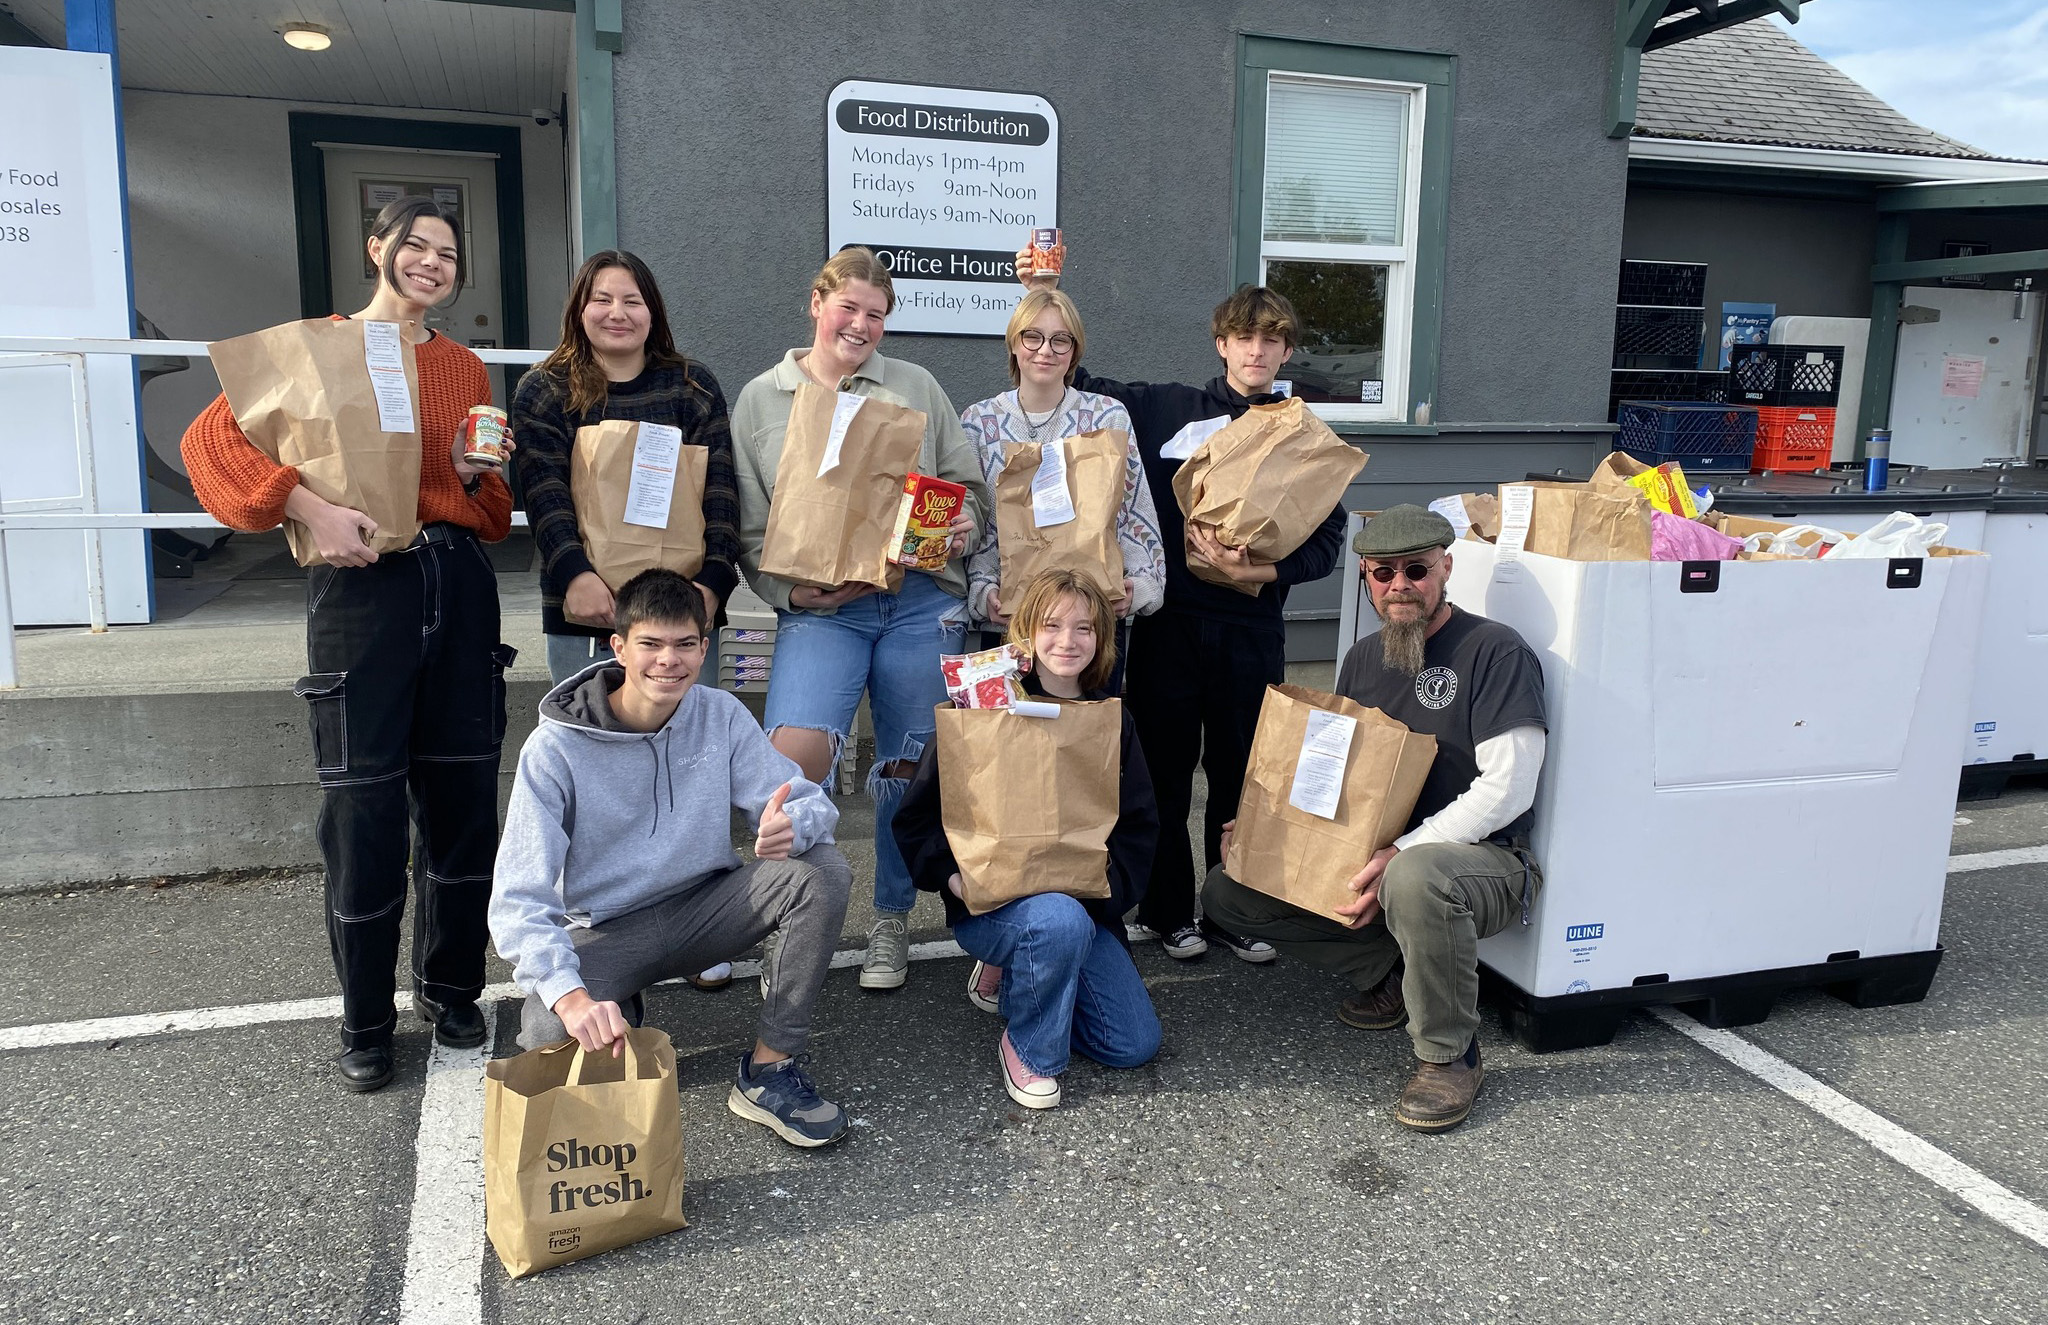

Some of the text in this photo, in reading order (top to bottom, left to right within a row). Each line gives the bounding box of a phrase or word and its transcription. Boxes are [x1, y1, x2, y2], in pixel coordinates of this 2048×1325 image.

[858, 106, 1029, 137] Food Distribution
[852, 146, 1025, 177] Mondays 1pm-4pm
[9, 169, 59, 187] Food
[853, 172, 1037, 200] Fridays 9am-Noon
[852, 199, 1036, 226] Saturdays 9am-Noon
[875, 250, 1014, 277] Office Hours
[895, 291, 965, 314] y-Friday
[915, 489, 958, 516] Stove
[926, 510, 947, 524] Top
[1569, 926, 1602, 939] ULINE
[547, 1138, 637, 1173] Shop
[548, 1172, 653, 1214] fresh.
[548, 1226, 581, 1237] amazon
[548, 1234, 581, 1249] fresh
